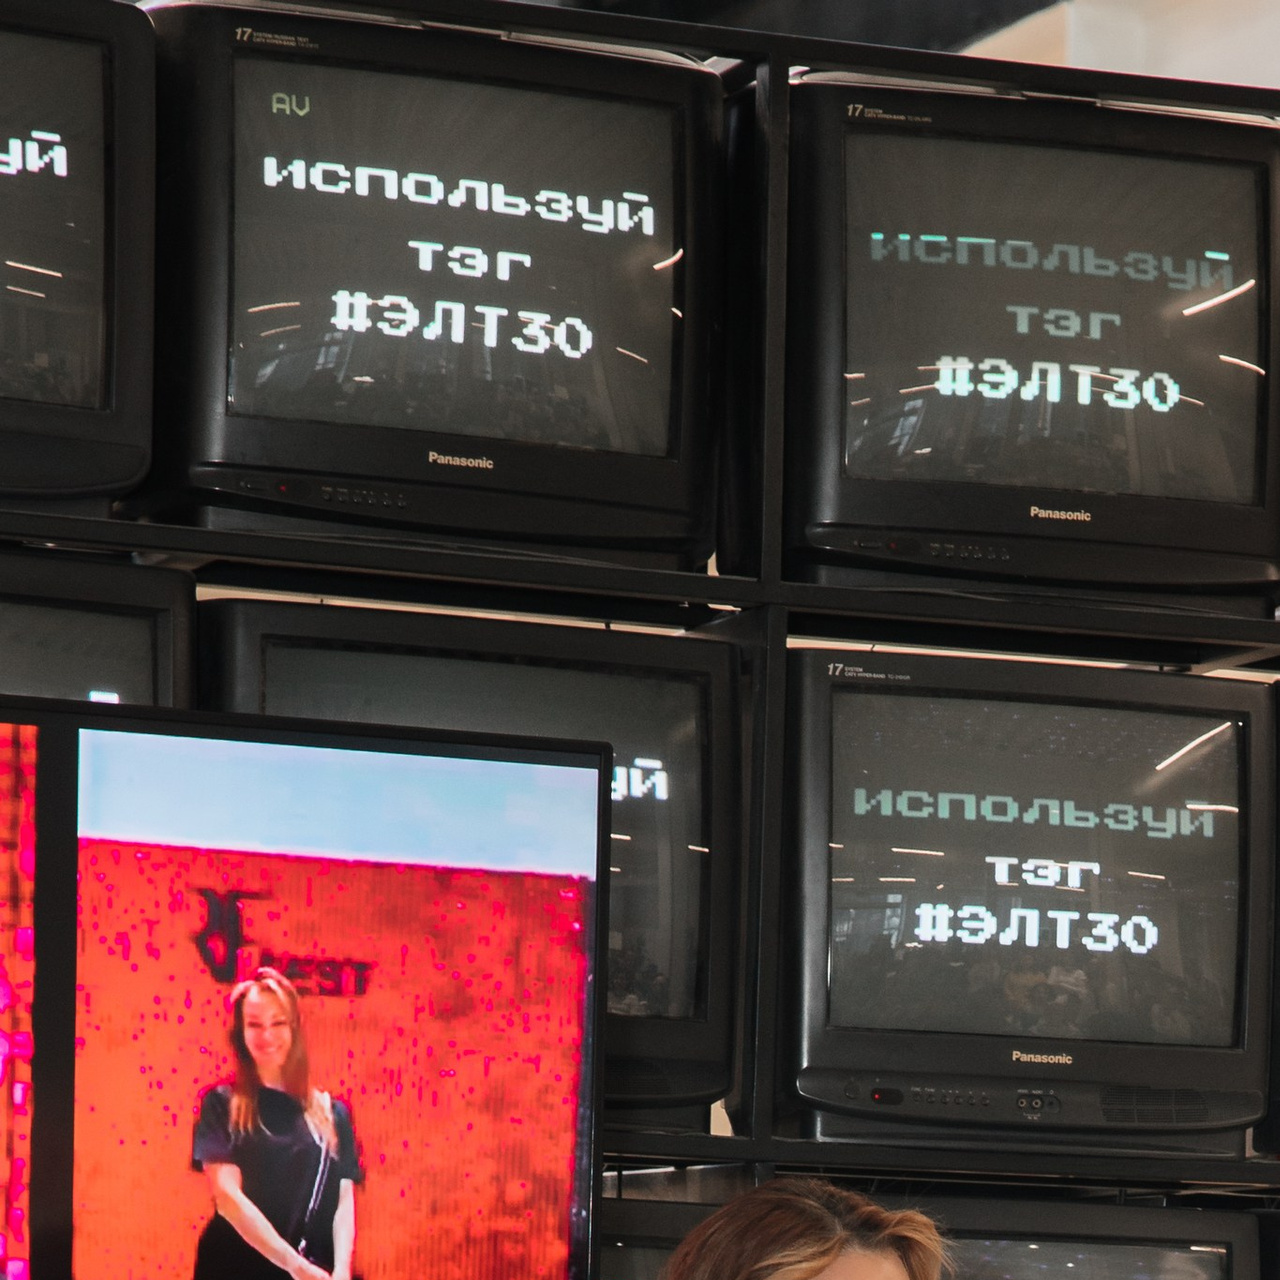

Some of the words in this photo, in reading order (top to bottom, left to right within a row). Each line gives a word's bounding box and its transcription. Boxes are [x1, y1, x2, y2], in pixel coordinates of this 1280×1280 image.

[271, 92, 310, 117] AV
[428, 451, 494, 469] Panasonic
[1030, 505, 1091, 522] Panasonic
[1012, 1050, 1073, 1065] Panasonic
